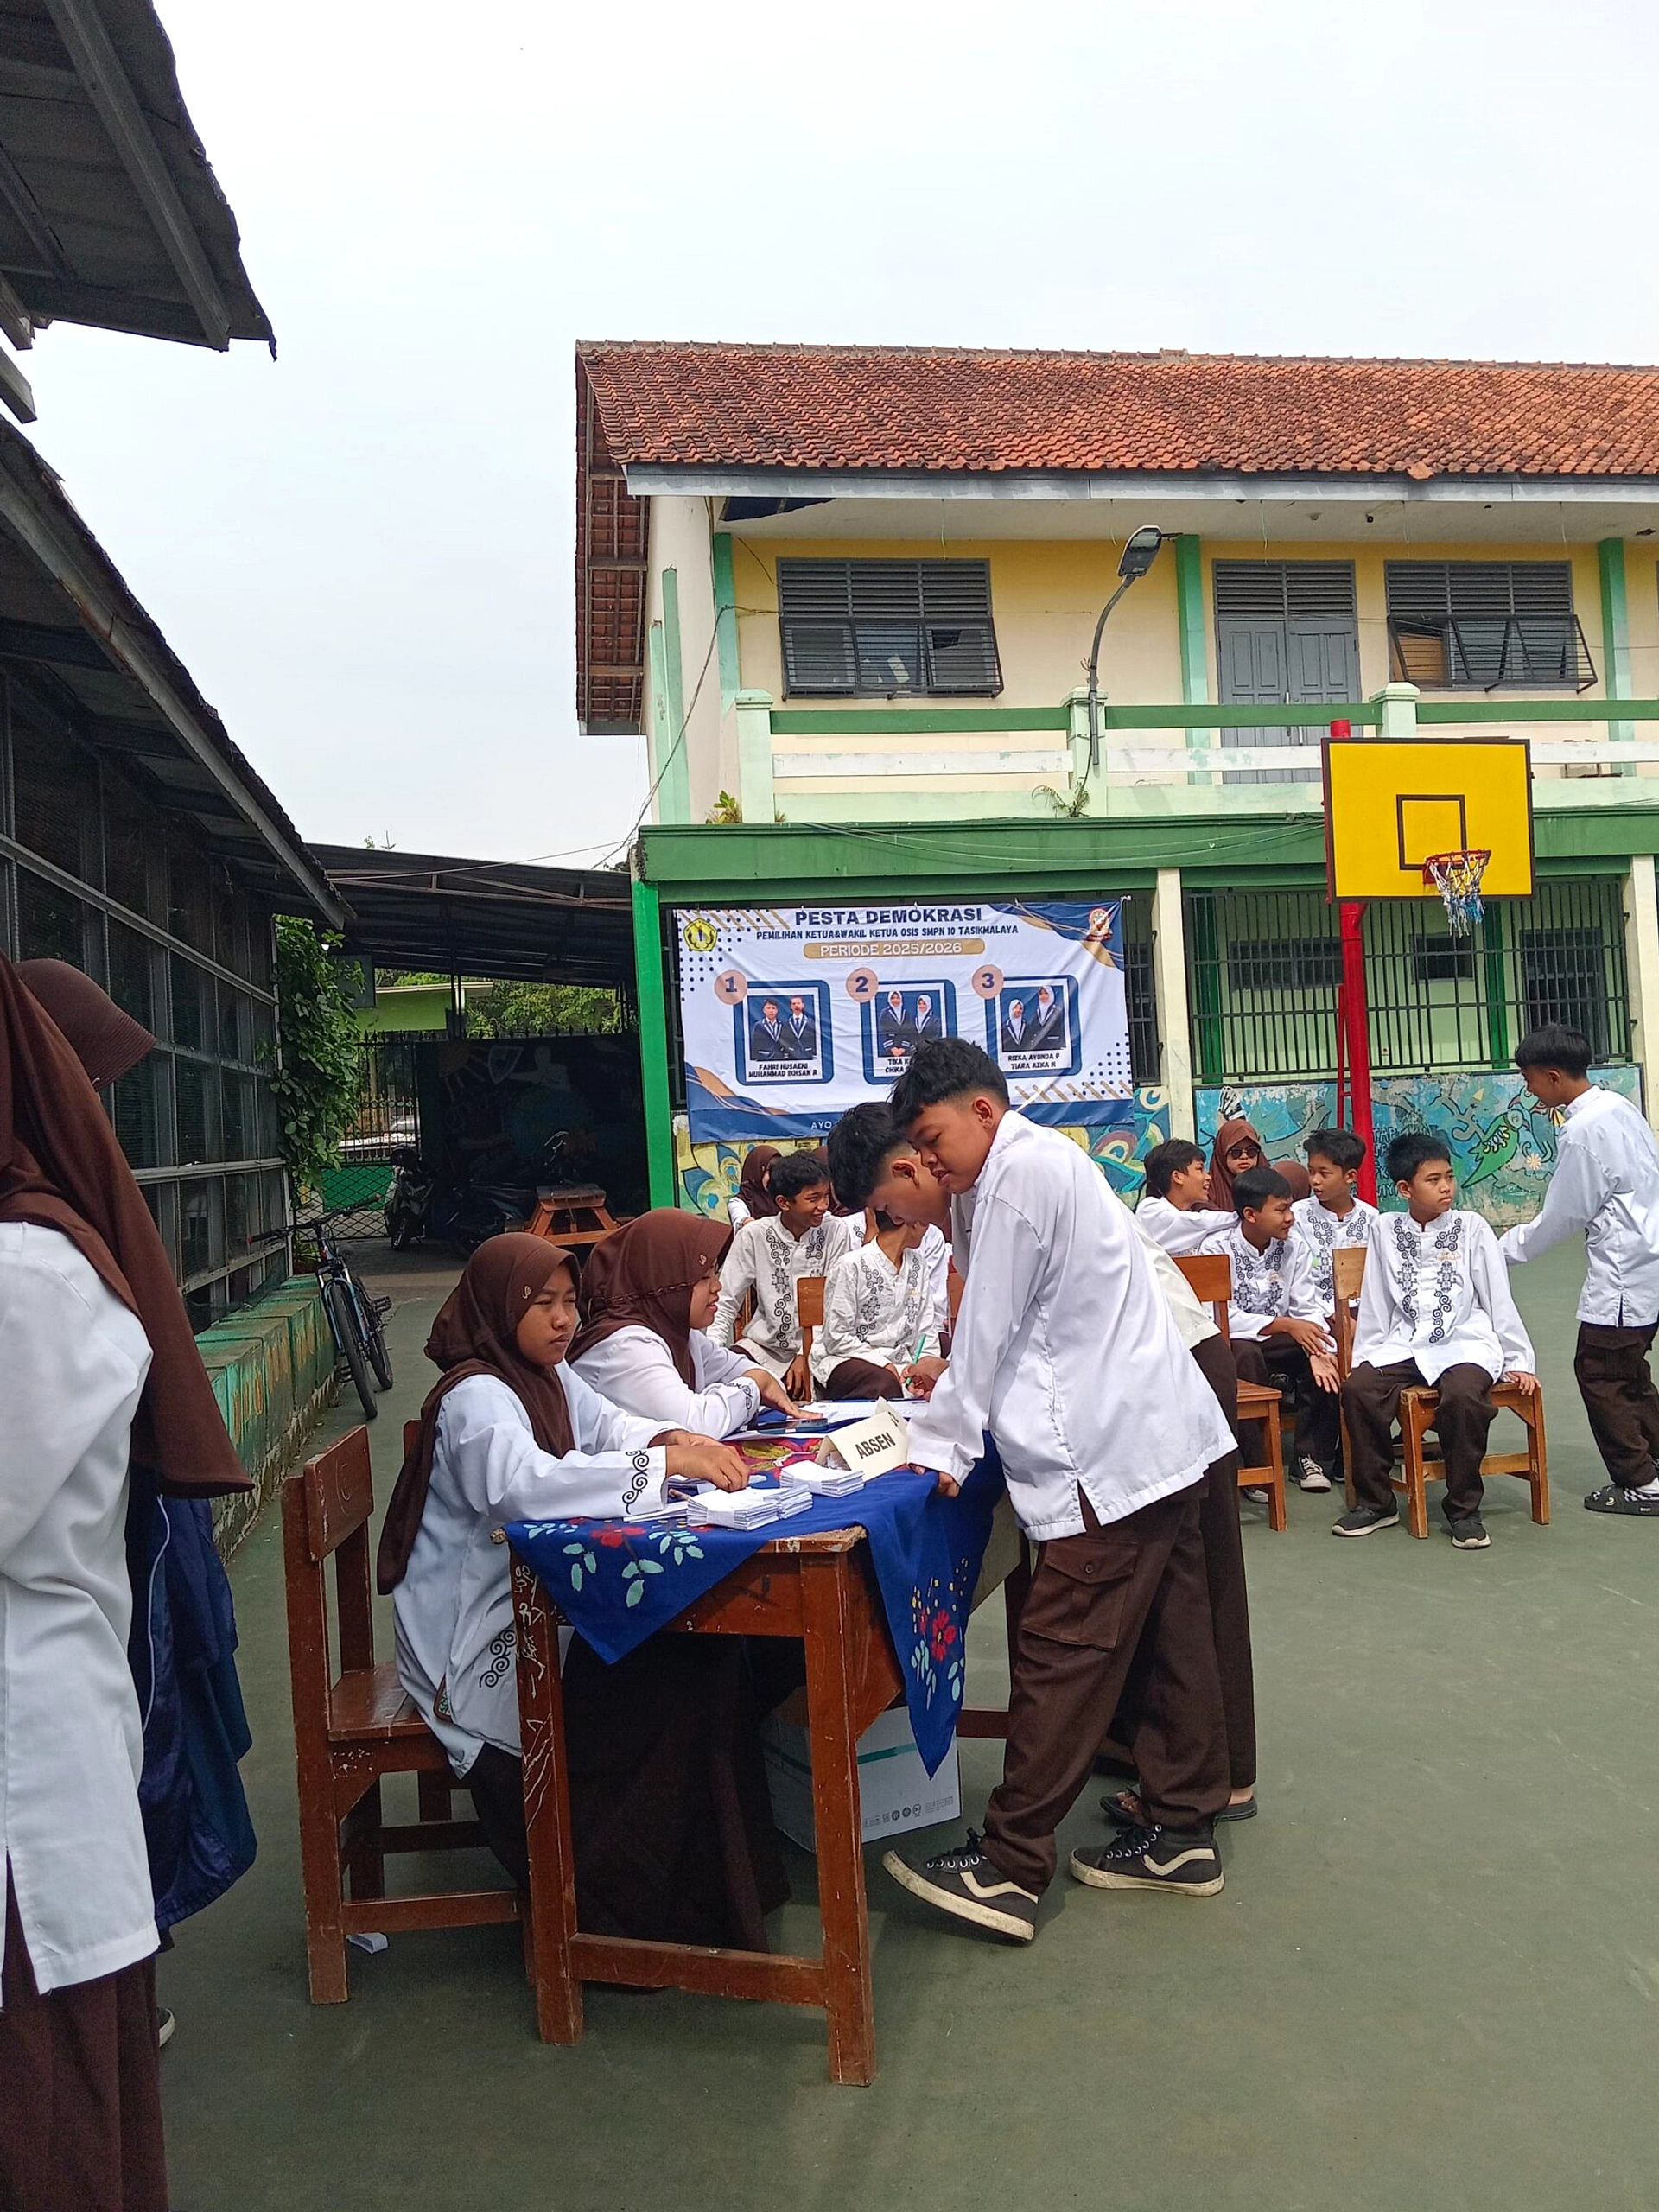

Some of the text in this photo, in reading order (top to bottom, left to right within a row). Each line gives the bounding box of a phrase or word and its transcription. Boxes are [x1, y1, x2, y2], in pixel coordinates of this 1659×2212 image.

[795, 908, 982, 925] PESTA DEMOKRASI
[756, 930, 803, 940] PEMILIHAN
[869, 928, 899, 938] KETUA
[900, 927, 919, 937] OSIS
[922, 926, 945, 936] SMPN
[947, 926, 956, 936] 10
[958, 925, 1019, 935] TASIKMALAYA
[821, 943, 963, 957] PERIODE 2025/2026
[724, 976, 738, 993] 1
[855, 976, 869, 993] 2
[981, 973, 995, 989] 3
[810, 1121, 832, 1129] AYO
[855, 1432, 896, 1459] ABSEN
